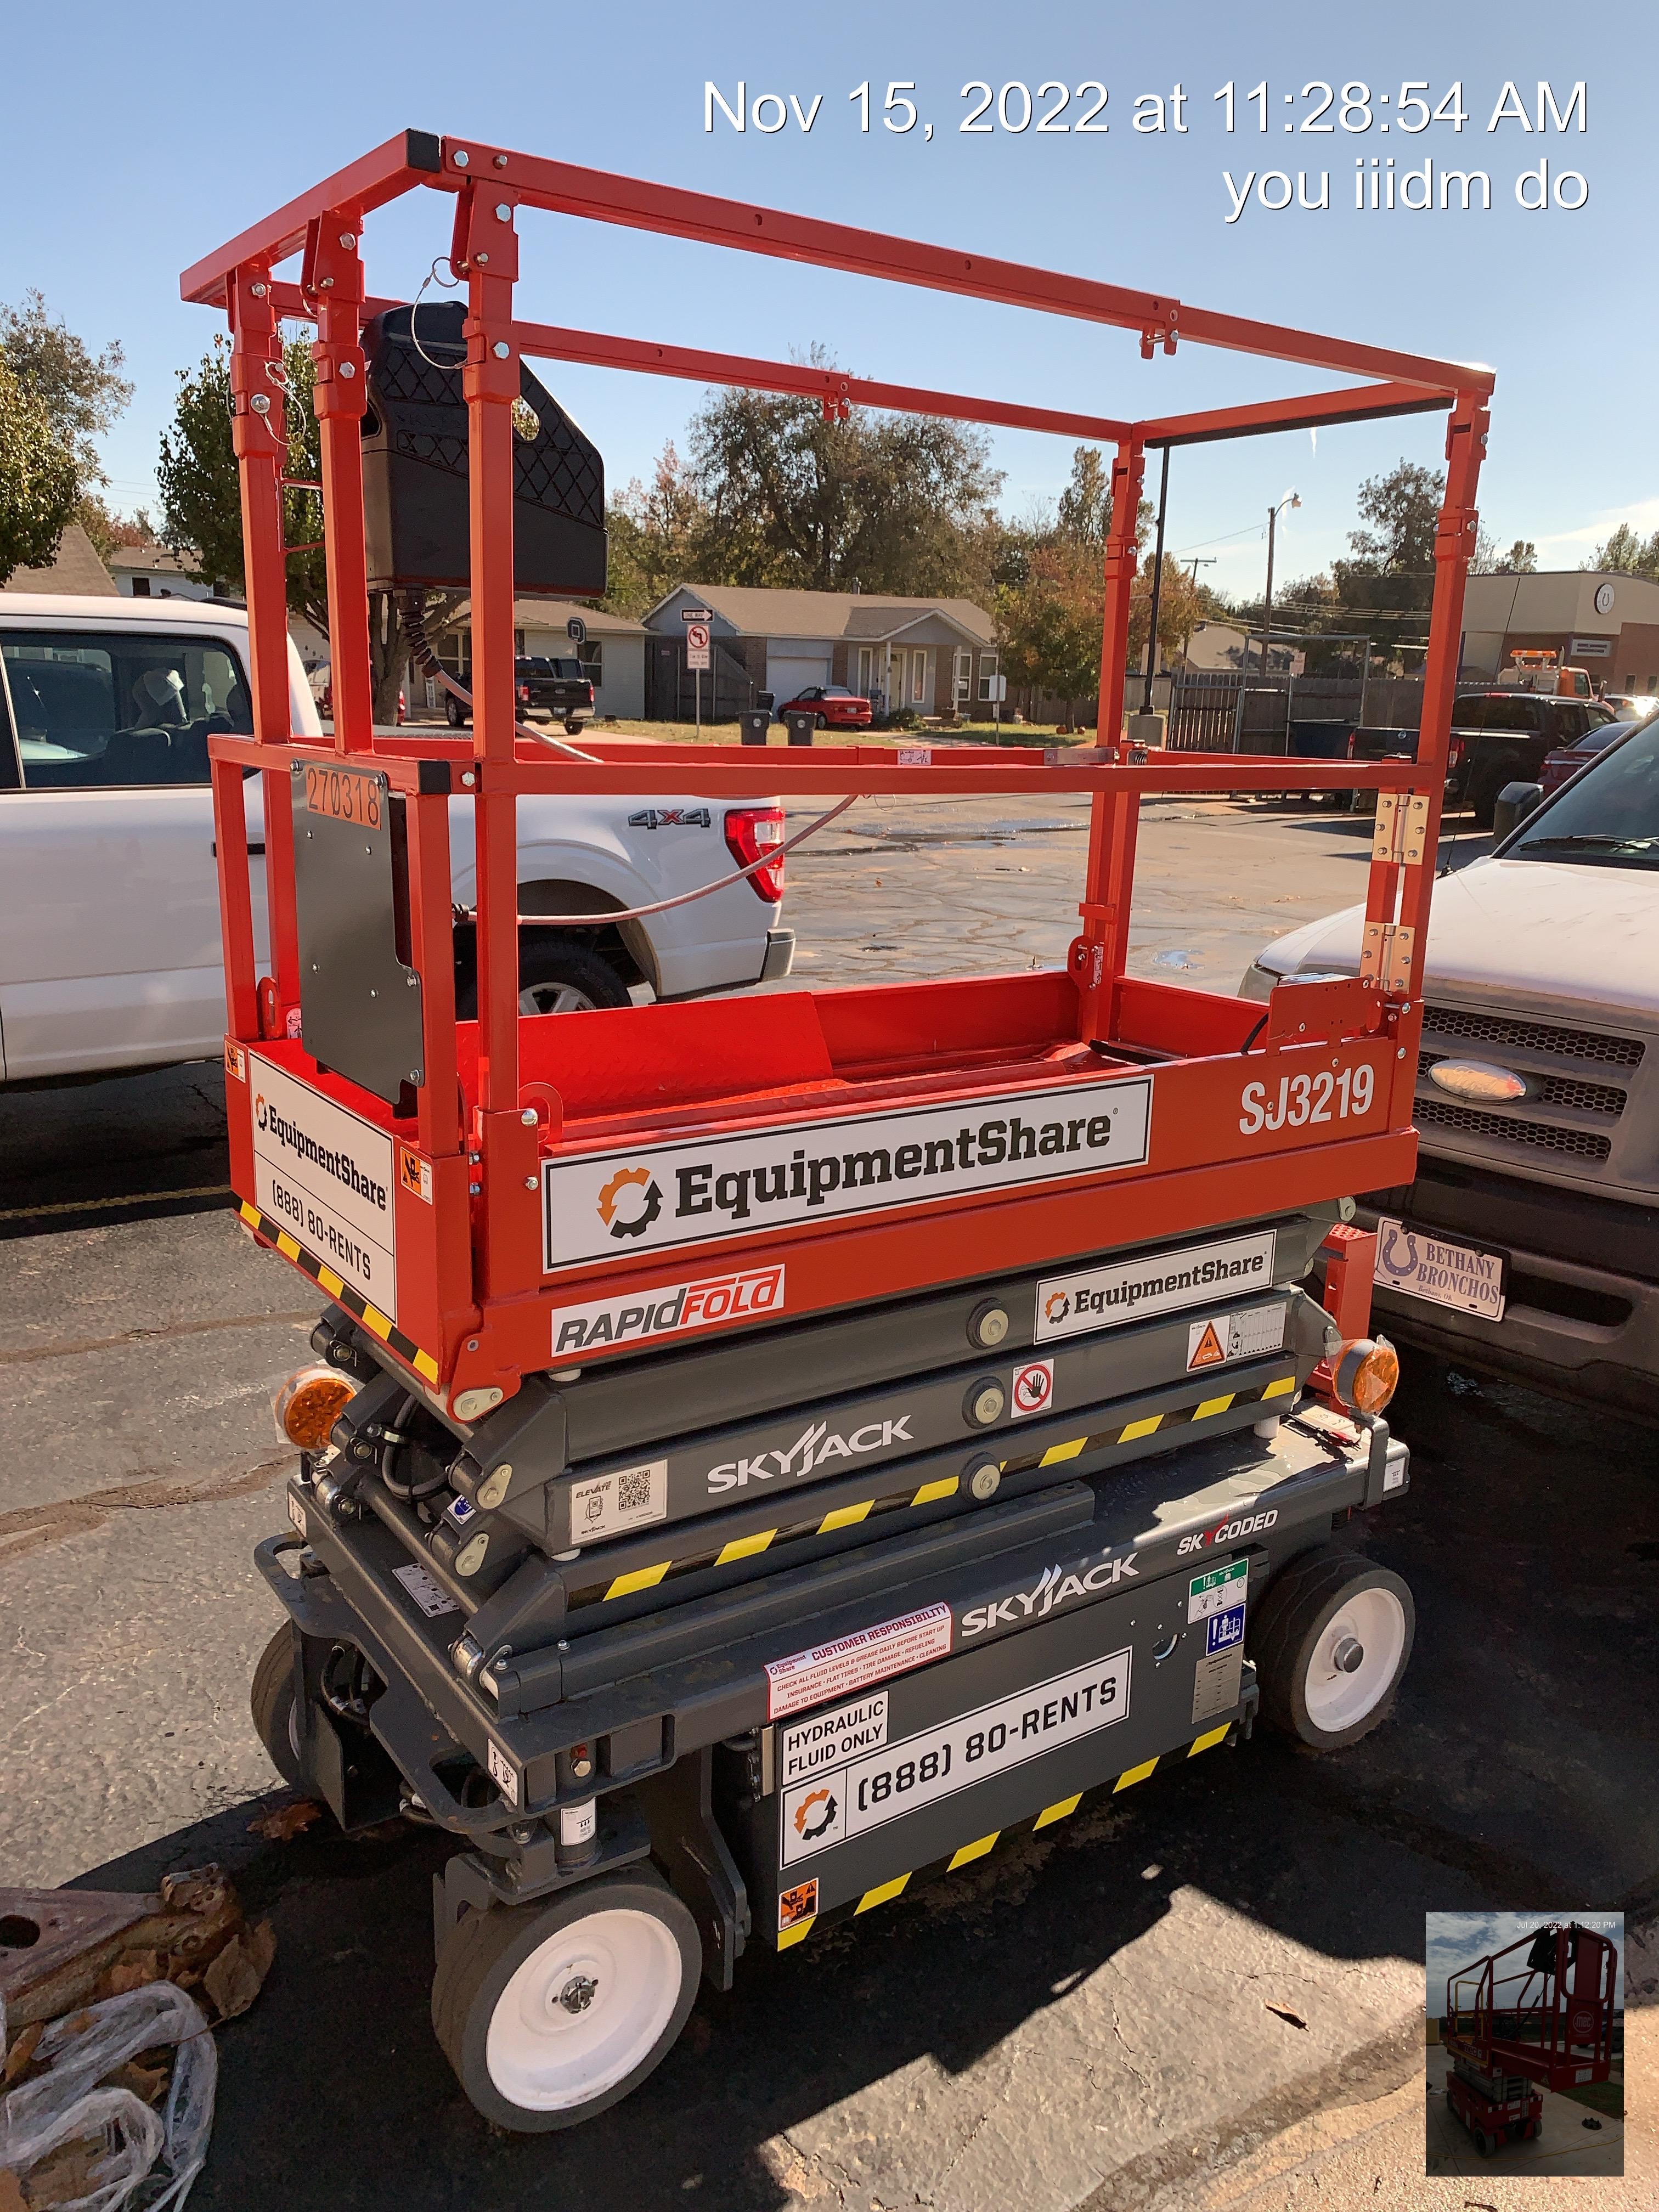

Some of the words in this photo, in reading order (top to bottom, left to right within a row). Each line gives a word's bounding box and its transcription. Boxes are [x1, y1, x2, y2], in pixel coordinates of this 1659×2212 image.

[308, 768, 379, 826] 270318
[1239, 1064, 1374, 1135] SJ3219
[269, 1104, 386, 1211] EquipmentShare
[675, 1115, 1112, 1220] EquipmentShare
[273, 1179, 303, 1227] (888)
[308, 1209, 371, 1280] 80-RENTS
[1074, 1255, 1263, 1314] EquipmentShare
[1416, 1263, 1499, 1304] BRONCHOS
[1426, 1243, 1495, 1280] BETHANY
[1444, 1293, 1453, 1301] OK
[707, 1414, 915, 1493] SKYJACK
[576, 1483, 611, 1498] ELEVATE
[961, 1552, 1140, 1637] SKYJACK
[777, 1679, 798, 1691] CHECK
[798, 1676, 809, 1684] ALL
[810, 1668, 828, 1679] FLUID
[829, 1660, 849, 1672] LEVELS
[856, 1650, 878, 1662] GREASE
[879, 1643, 896, 1654] DAILY
[896, 1635, 918, 1647] BEFORE
[918, 1628, 935, 1639] START
[812, 1634, 868, 1661] CUSTOMER
[867, 1605, 946, 1640] RESPONSIBILITY
[774, 1700, 799, 1714] DAMAGE
[810, 1683, 844, 1700] EQUIPMENT
[849, 1672, 874, 1686] BATTERY
[874, 1656, 915, 1676] MAINTENANCE
[919, 1644, 946, 1658] CLEANING
[778, 1664, 795, 1674] Share
[787, 1681, 822, 1699] INSURANCE
[826, 1674, 840, 1684] FLAT
[841, 1667, 859, 1678] TIRES
[863, 1660, 876, 1670] TIRE
[877, 1651, 901, 1664] DAMAGE
[905, 1638, 935, 1654] REFUELING
[788, 1701, 884, 1752] HYDRAULIC
[788, 1743, 836, 1775] FLUID
[840, 1724, 883, 1753] ONLY
[858, 1744, 951, 1812] (888)
[966, 1677, 1116, 1763] 80-RENTS
